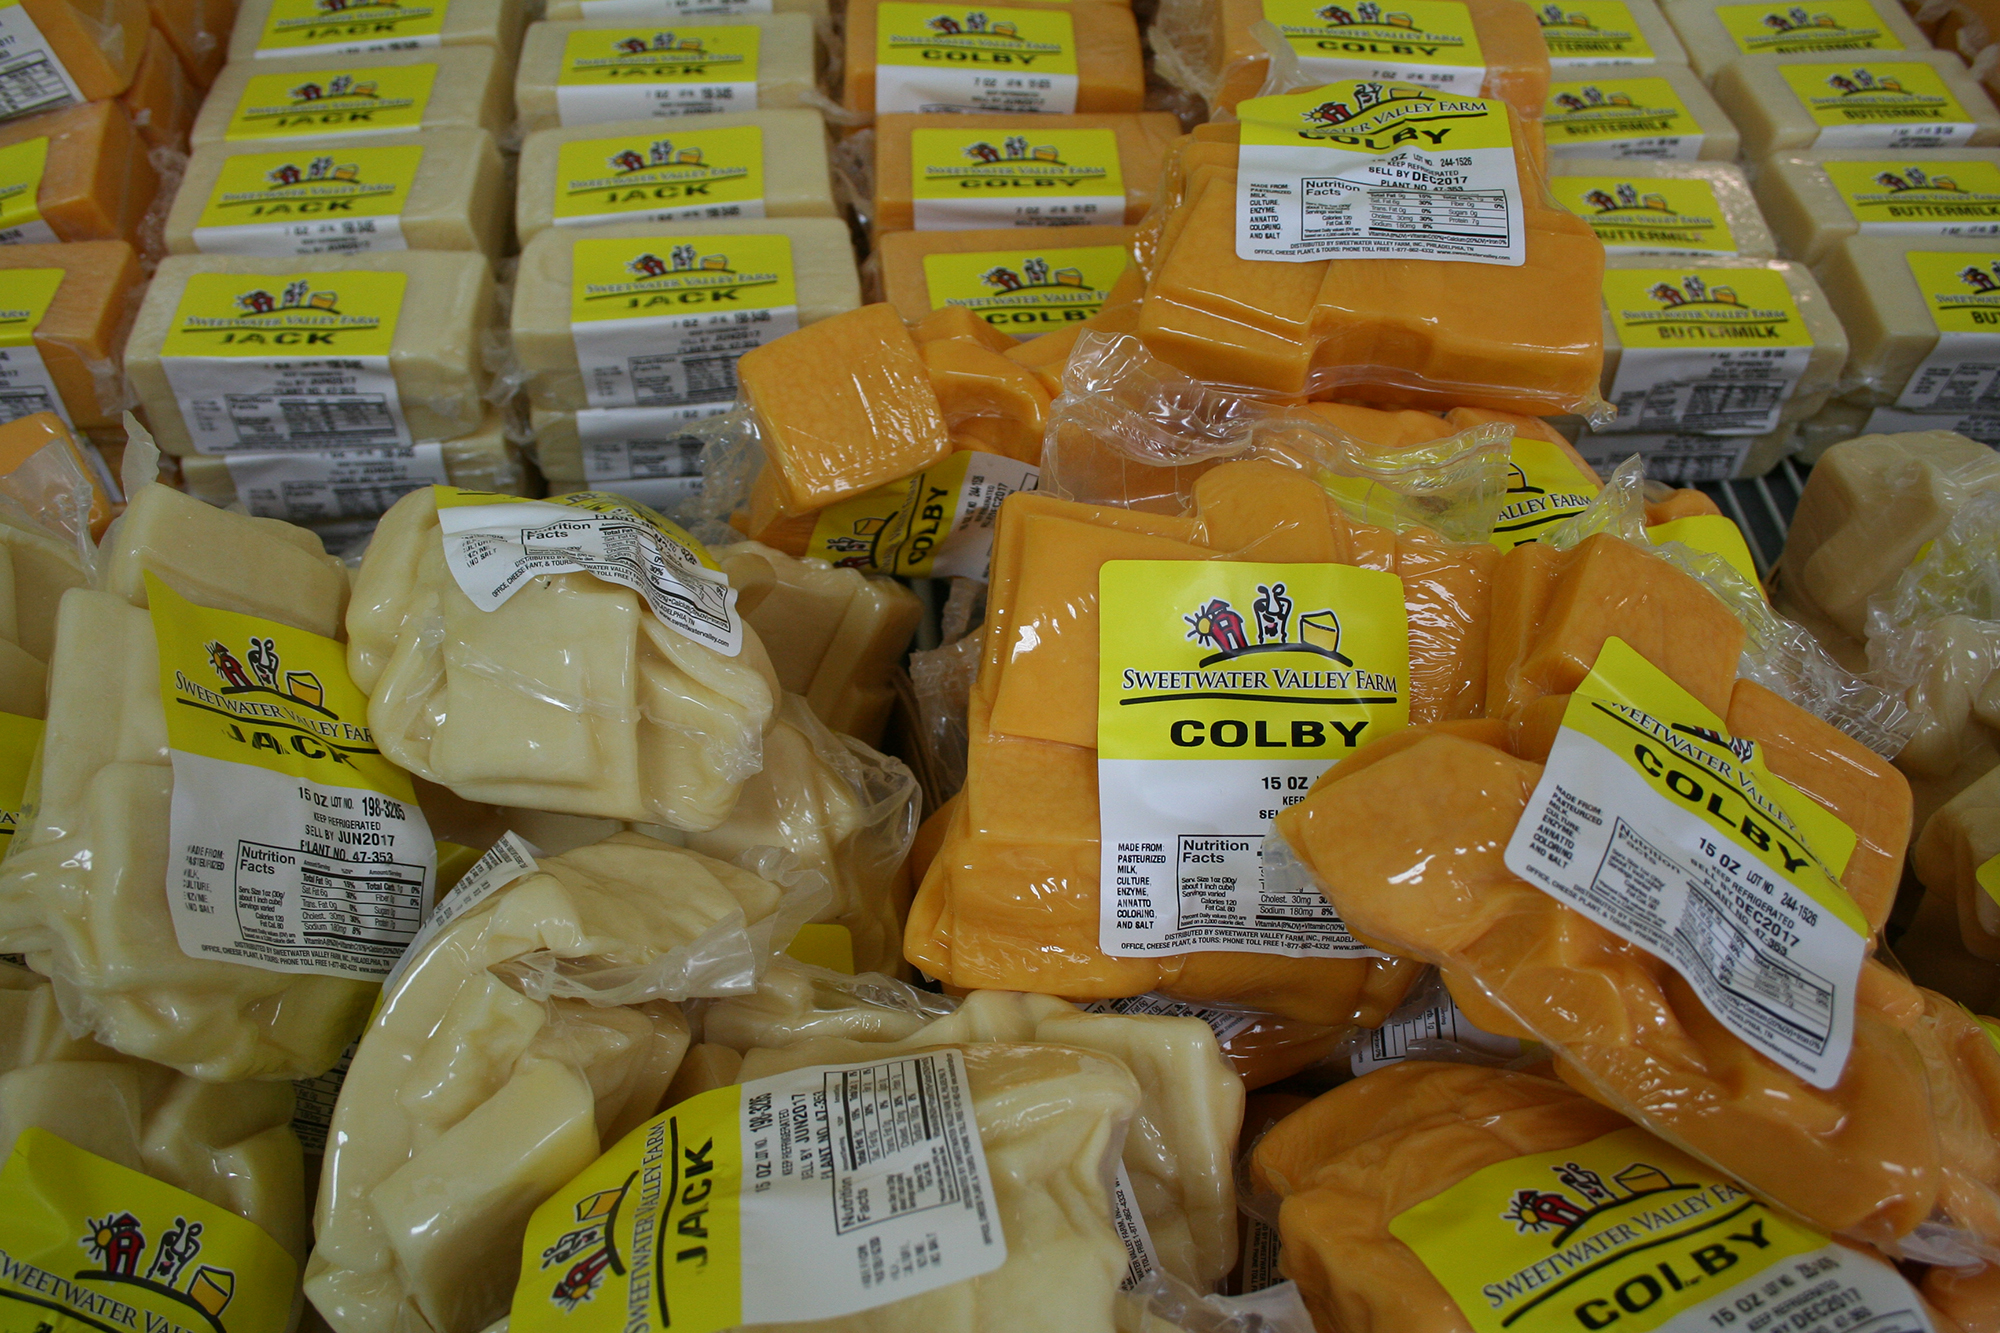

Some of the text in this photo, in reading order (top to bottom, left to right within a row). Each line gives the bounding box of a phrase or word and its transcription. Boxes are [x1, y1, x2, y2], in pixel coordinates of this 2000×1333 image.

[307, 22, 393, 38] JACK
[922, 49, 1036, 65] COLBY
[1317, 41, 1438, 56] COLBY
[609, 66, 705, 76] JACK
[277, 110, 373, 128] JACK
[1372, 101, 1487, 124] VALLEY FARM
[1441, 157, 1472, 167] 244-1526
[961, 178, 1082, 188] COLBY
[1369, 166, 1468, 186] SELL BY DEC2017
[1380, 180, 1409, 189] PLANT
[608, 184, 710, 203] JACK
[1306, 181, 1360, 192] Nutrition
[1306, 188, 1341, 196] Facts
[251, 200, 352, 216] JACK
[627, 289, 740, 309] JACK
[221, 332, 334, 346] JACK
[1658, 325, 1779, 339] BUTTERMILK
[1498, 493, 1592, 521] ALLEY FARM
[908, 486, 948, 565] COLBY
[526, 530, 569, 541] Facts
[1123, 669, 1397, 693] SWEETWATER VALLEY FARM
[175, 670, 375, 744] SWEETWATER VALLEY FAR
[1170, 720, 1369, 748] COLBY
[1606, 700, 1796, 831] WEETWATER VALLEY
[1261, 776, 1309, 790] 15 OZ
[298, 786, 312, 801] 15
[314, 793, 329, 808] OZ
[331, 795, 342, 809] LOT
[1635, 743, 1809, 874] COLBY
[313, 812, 381, 831] KEEP REFRIGERATED
[305, 824, 395, 847] SELL BY JUN2017
[300, 840, 394, 864] PLANT NO. 47-353
[1118, 843, 1165, 852] MADE FROM:
[1183, 839, 1249, 851] Nutrition
[241, 846, 296, 865] Nutrition
[1118, 855, 1166, 864] PASTEURIZED
[1183, 852, 1225, 864] Facts
[240, 859, 276, 875] Facts
[1117, 865, 1138, 875] MILK,
[1117, 877, 1151, 886] CULTURE,
[1699, 837, 1717, 857] 15
[1719, 854, 1741, 876] OZ
[1746, 870, 1763, 886] LOT
[1780, 892, 1818, 927] 244-1526
[1117, 888, 1149, 897] ENZYME,
[1208, 890, 1226, 898] varied
[1261, 894, 1312, 905] Cholest. 30mg
[1117, 899, 1151, 908] ANNATTO
[1200, 898, 1225, 906] Calories
[1227, 905, 1236, 913] 80
[1732, 882, 1795, 929] REFRIGERATED
[1117, 910, 1157, 919] COLORING,
[1260, 906, 1333, 917] Sodium 180mg 8%
[1117, 921, 1154, 929] AND SALT
[1735, 896, 1800, 947] DEC2017
[1121, 942, 1145, 951] OFFICE,
[1147, 941, 1170, 950] CHEESE
[1171, 938, 1191, 948] PLANT,
[1198, 936, 1221, 944] TOURS:
[1222, 937, 1245, 945] PHONE
[1246, 938, 1261, 946] TOLL
[1262, 939, 1279, 947] FREE
[1165, 930, 1203, 941] DISTRIBUTED
[1215, 929, 1259, 939] SWEETWATER
[1260, 931, 1284, 941] VALLEY
[1285, 933, 1304, 942] FARM,
[791, 1093, 813, 1163] BY JUN2017
[643, 1120, 666, 1165] FARM
[756, 1162, 771, 1179] OZ
[635, 1164, 662, 1213] VALLEY
[677, 1136, 713, 1274] JACK
[841, 1176, 855, 1228] Nutrition
[857, 1188, 871, 1223] Facts
[1134, 1238, 1145, 1255] FREE
[1483, 1192, 1713, 1308] SWEETWATER VALLEY
[1574, 1219, 1770, 1331] COLBY
[0, 1252, 138, 1329] WEETWATER
[1710, 1293, 1765, 1327] 15 OZ
[1790, 1286, 1862, 1329] DEC2017
